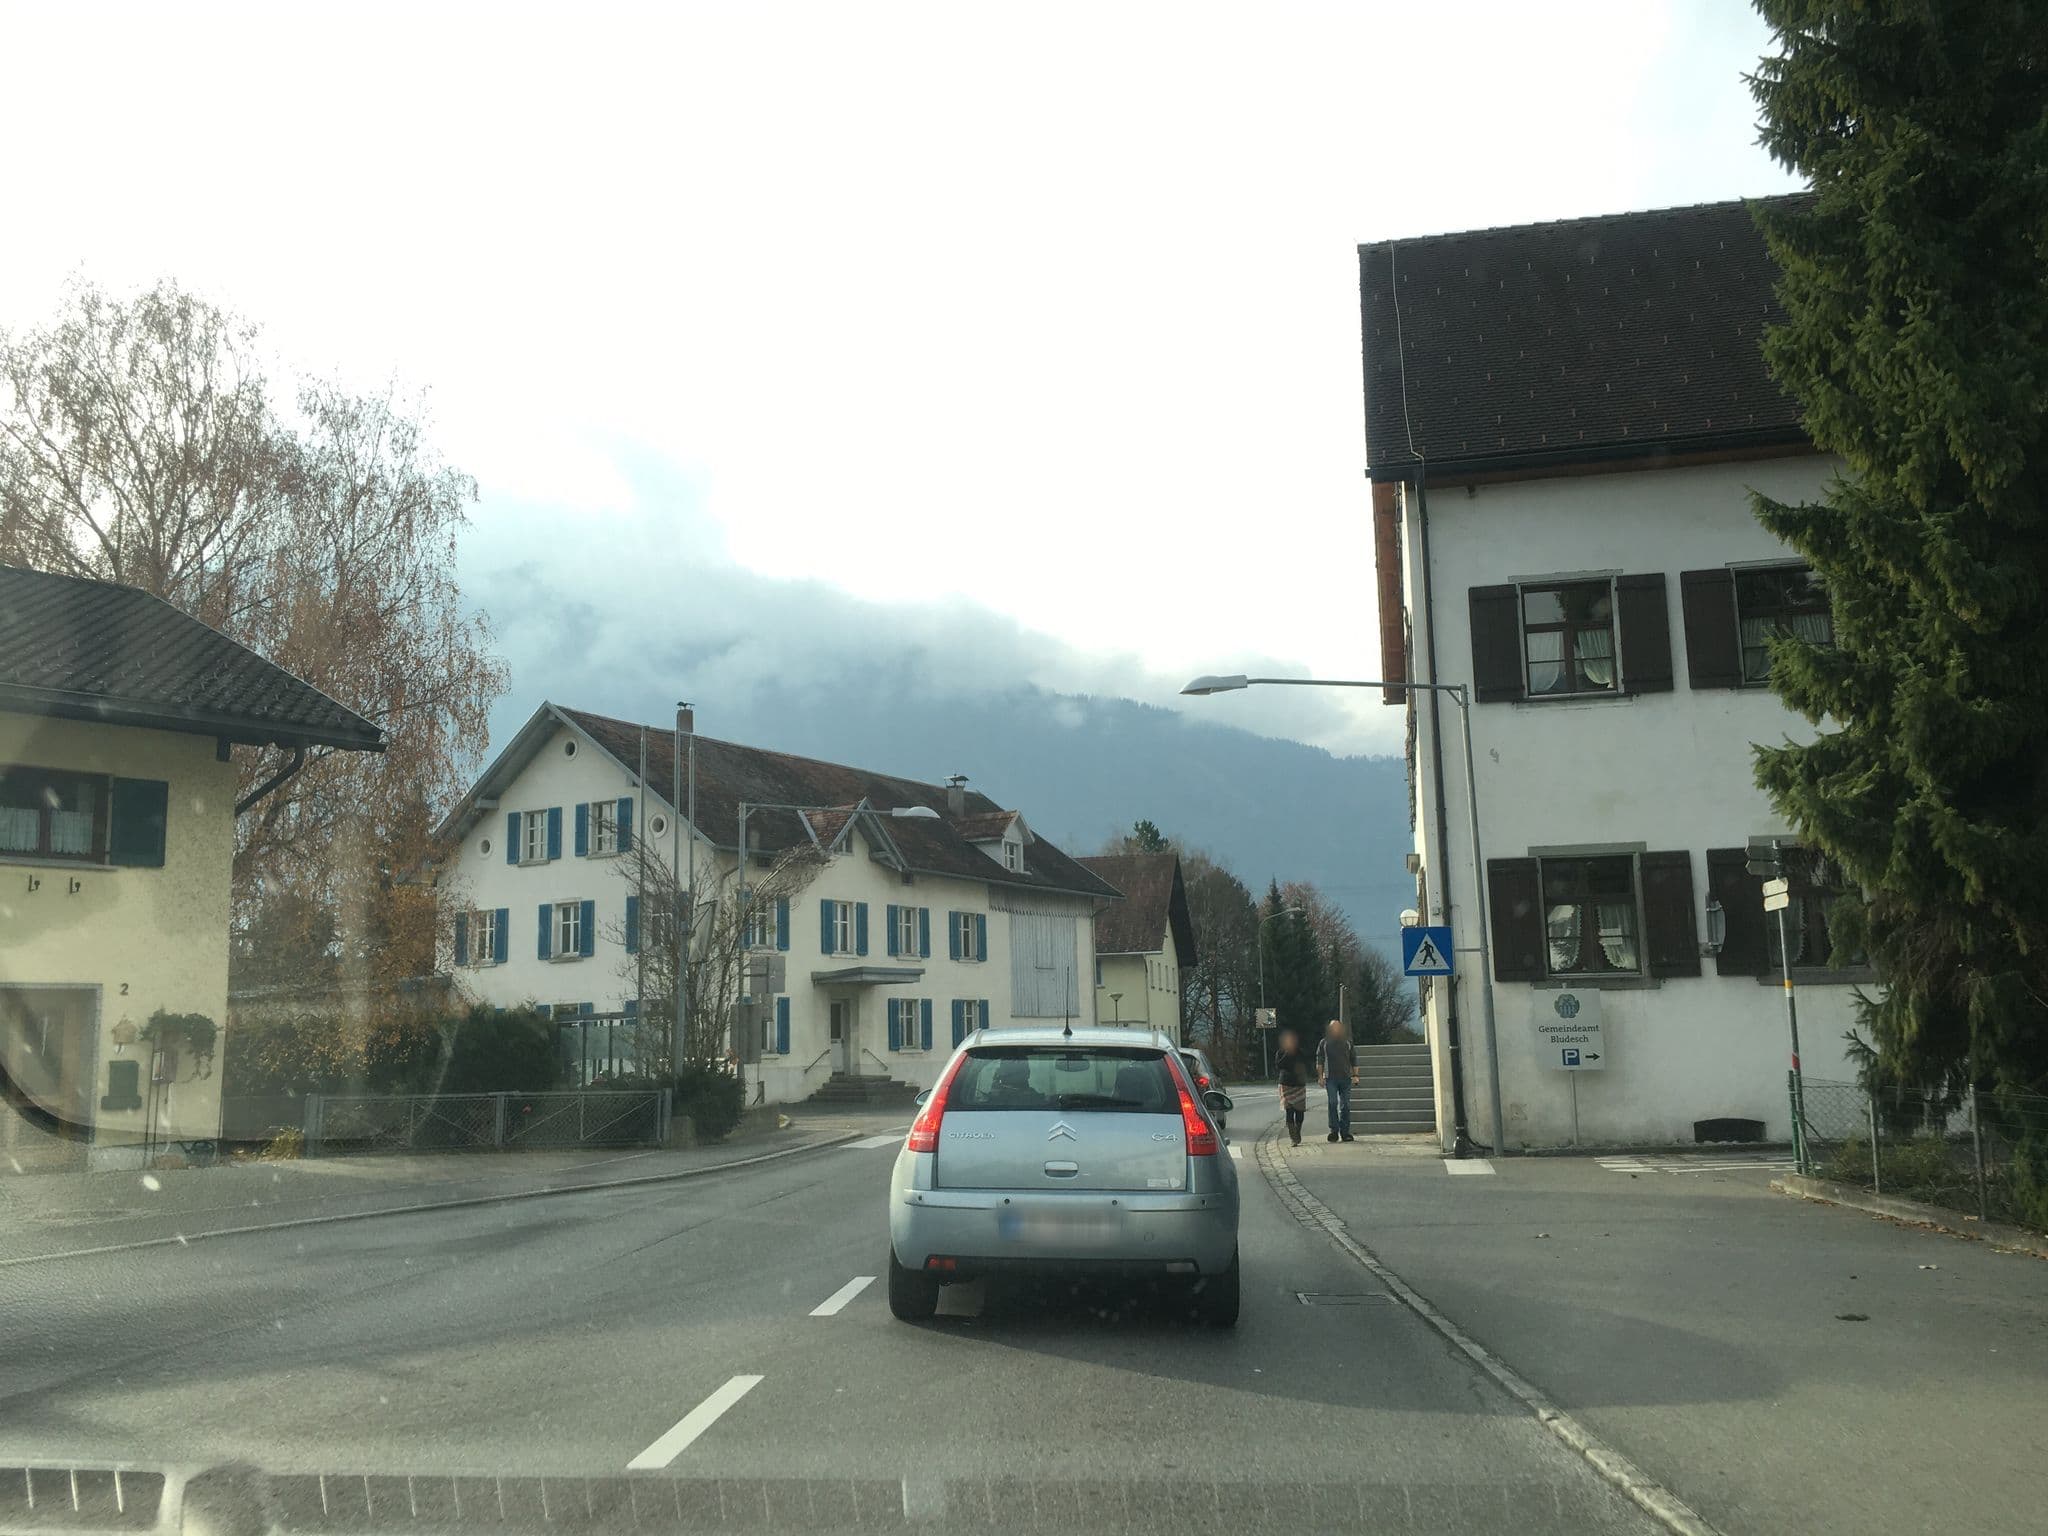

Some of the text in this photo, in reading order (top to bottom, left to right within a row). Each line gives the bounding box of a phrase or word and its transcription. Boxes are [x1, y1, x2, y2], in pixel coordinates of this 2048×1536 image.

[120, 982, 129, 996] 2
[1538, 1024, 1600, 1033] Gemeindeamt
[1550, 1034, 1589, 1043] Bludesch
[1564, 1050, 1578, 1064] P
[1151, 1132, 1178, 1142] C4
